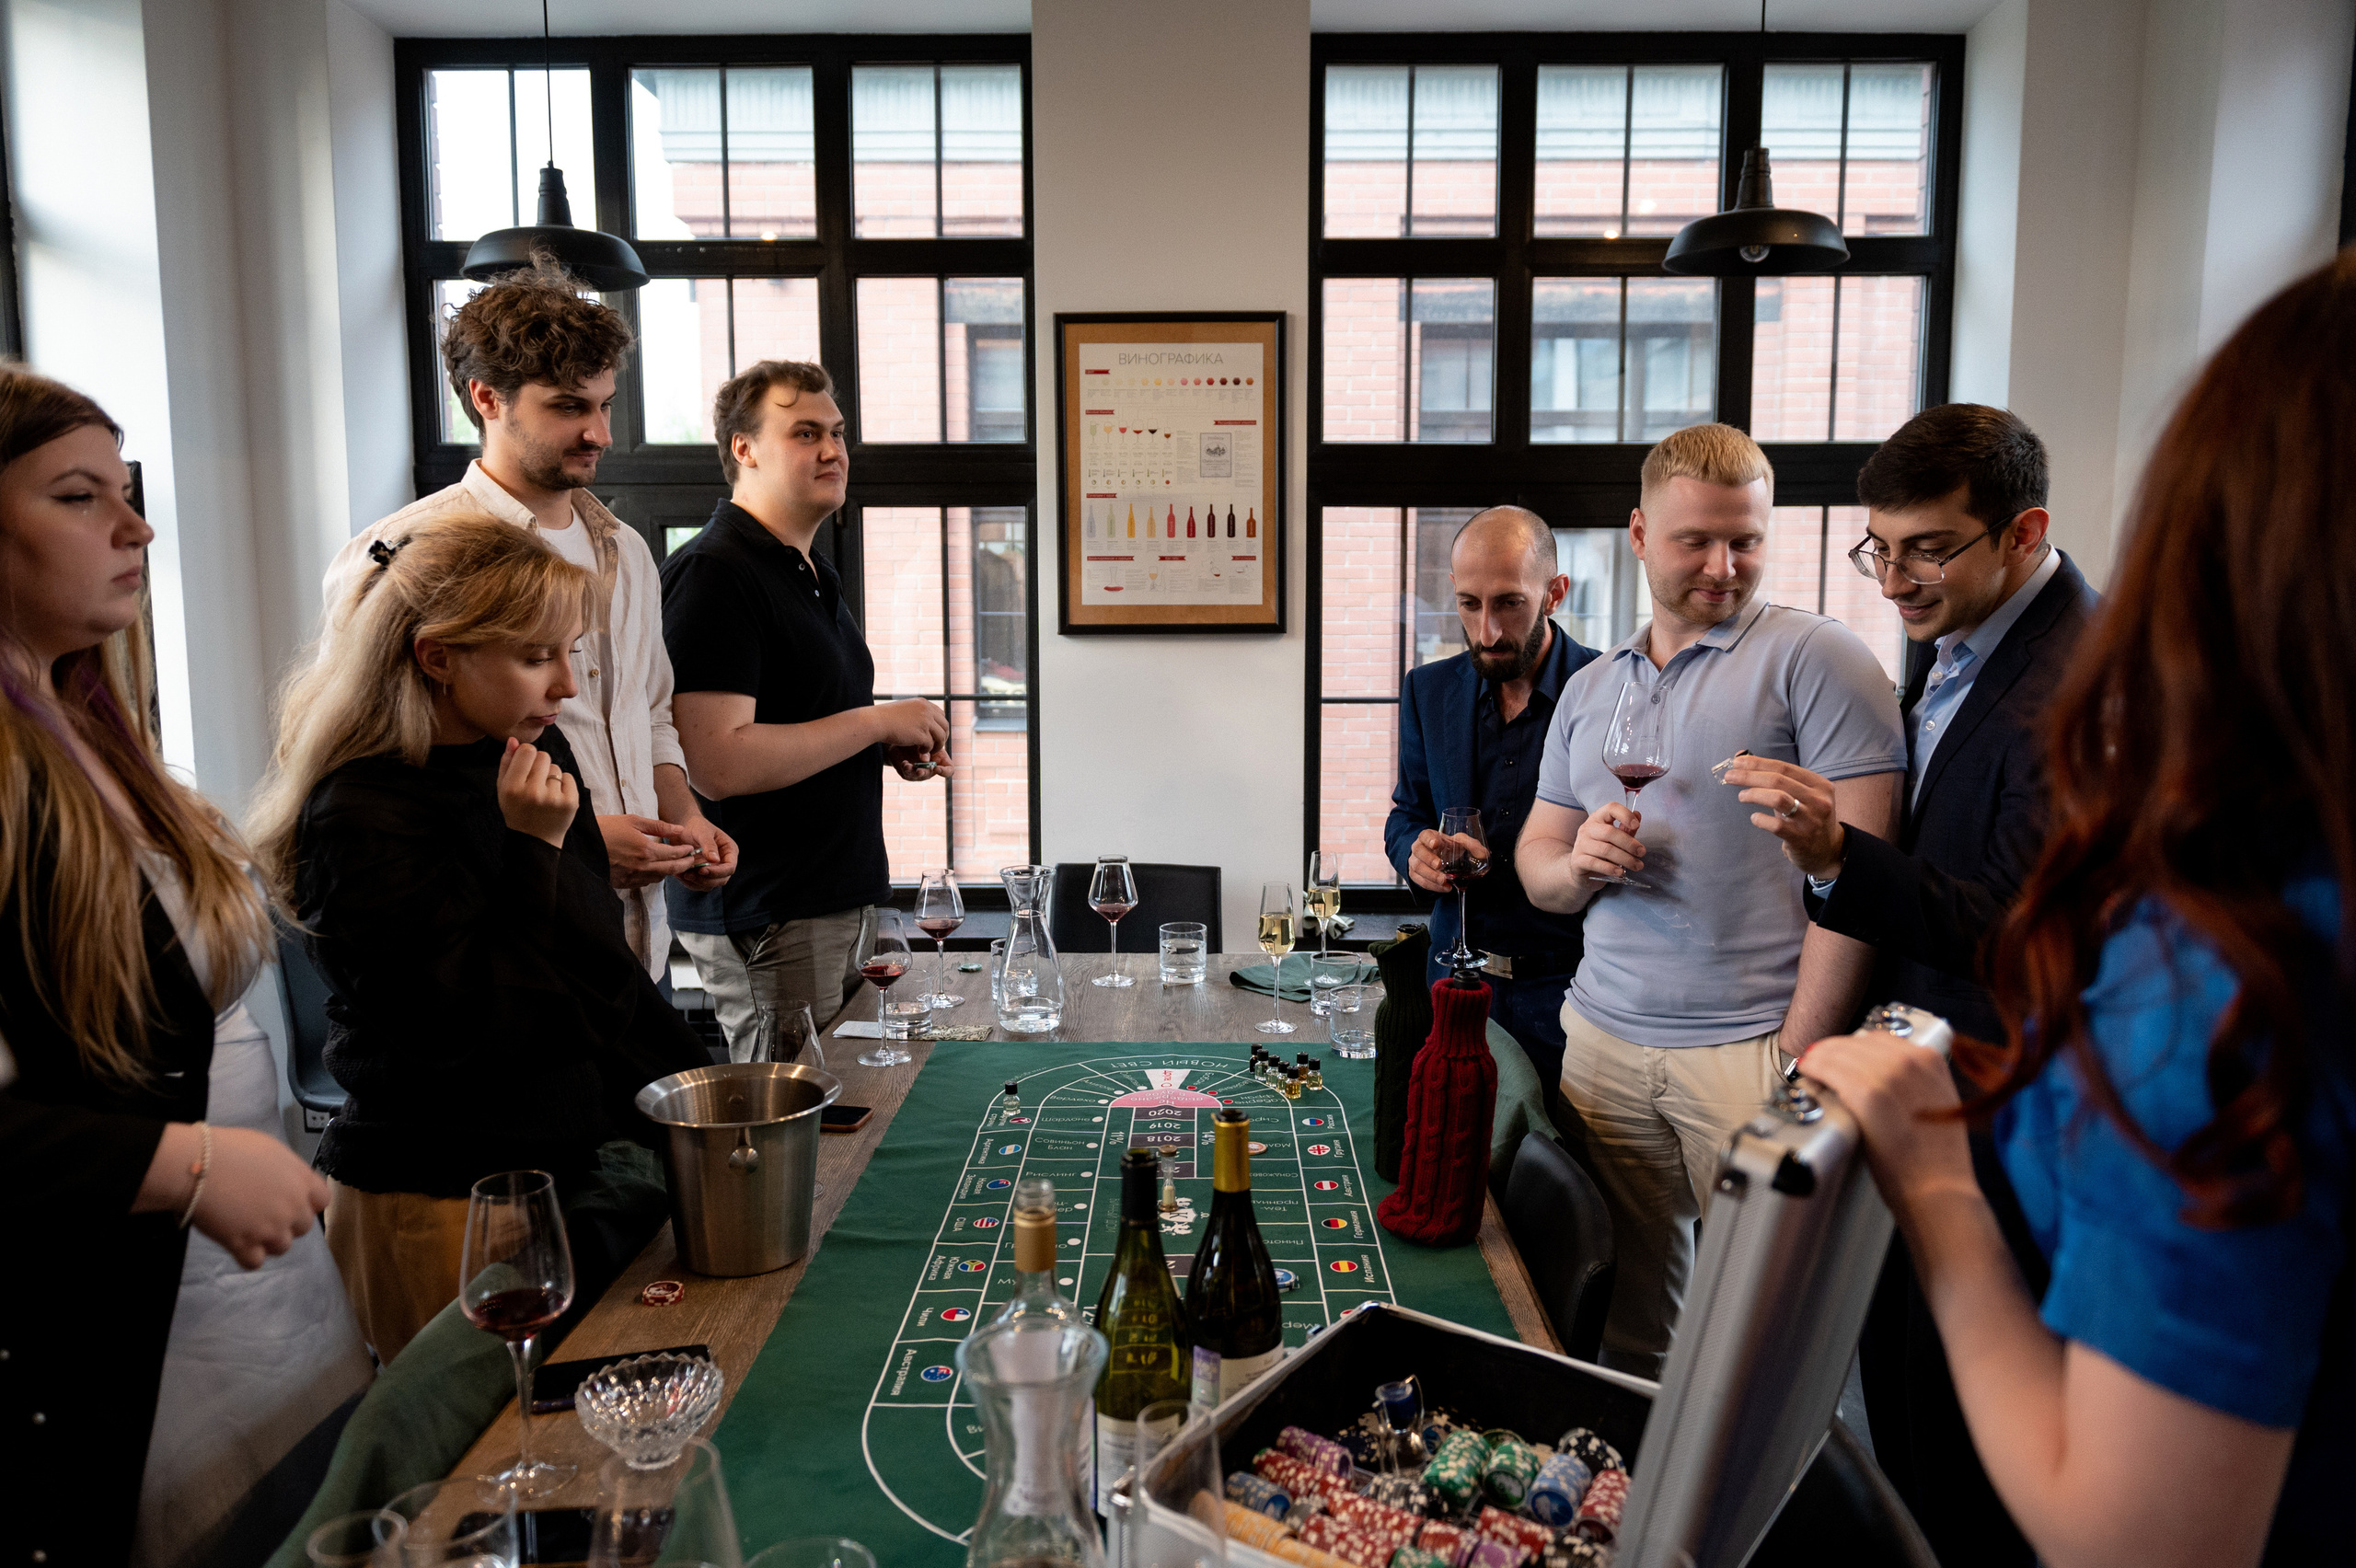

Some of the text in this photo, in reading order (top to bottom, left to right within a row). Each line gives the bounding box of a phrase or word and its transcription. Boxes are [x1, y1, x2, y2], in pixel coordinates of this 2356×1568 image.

[1118, 352, 1224, 365] ВИНОГРАФИКА
[1110, 1059, 1229, 1068] НОВЫЙ СВЕТ
[1148, 1109, 1183, 1117] 2020
[1326, 1114, 1335, 1129] Россия
[1034, 1136, 1085, 1146] Совиньон
[1109, 1132, 1125, 1146] 11%
[1201, 1130, 1216, 1146] 14%
[1334, 1139, 1345, 1158] Грузия
[958, 1174, 976, 1199] Зеландия
[974, 1178, 987, 1194] Новая
[1342, 1174, 1353, 1197] Австрия
[952, 1216, 966, 1232] США
[1350, 1210, 1364, 1239] Германия
[928, 1254, 946, 1280] Африка
[942, 1256, 960, 1279] Южная
[1361, 1254, 1375, 1283] Испания
[917, 1307, 934, 1327] Чили
[890, 1348, 918, 1396] Австралия
